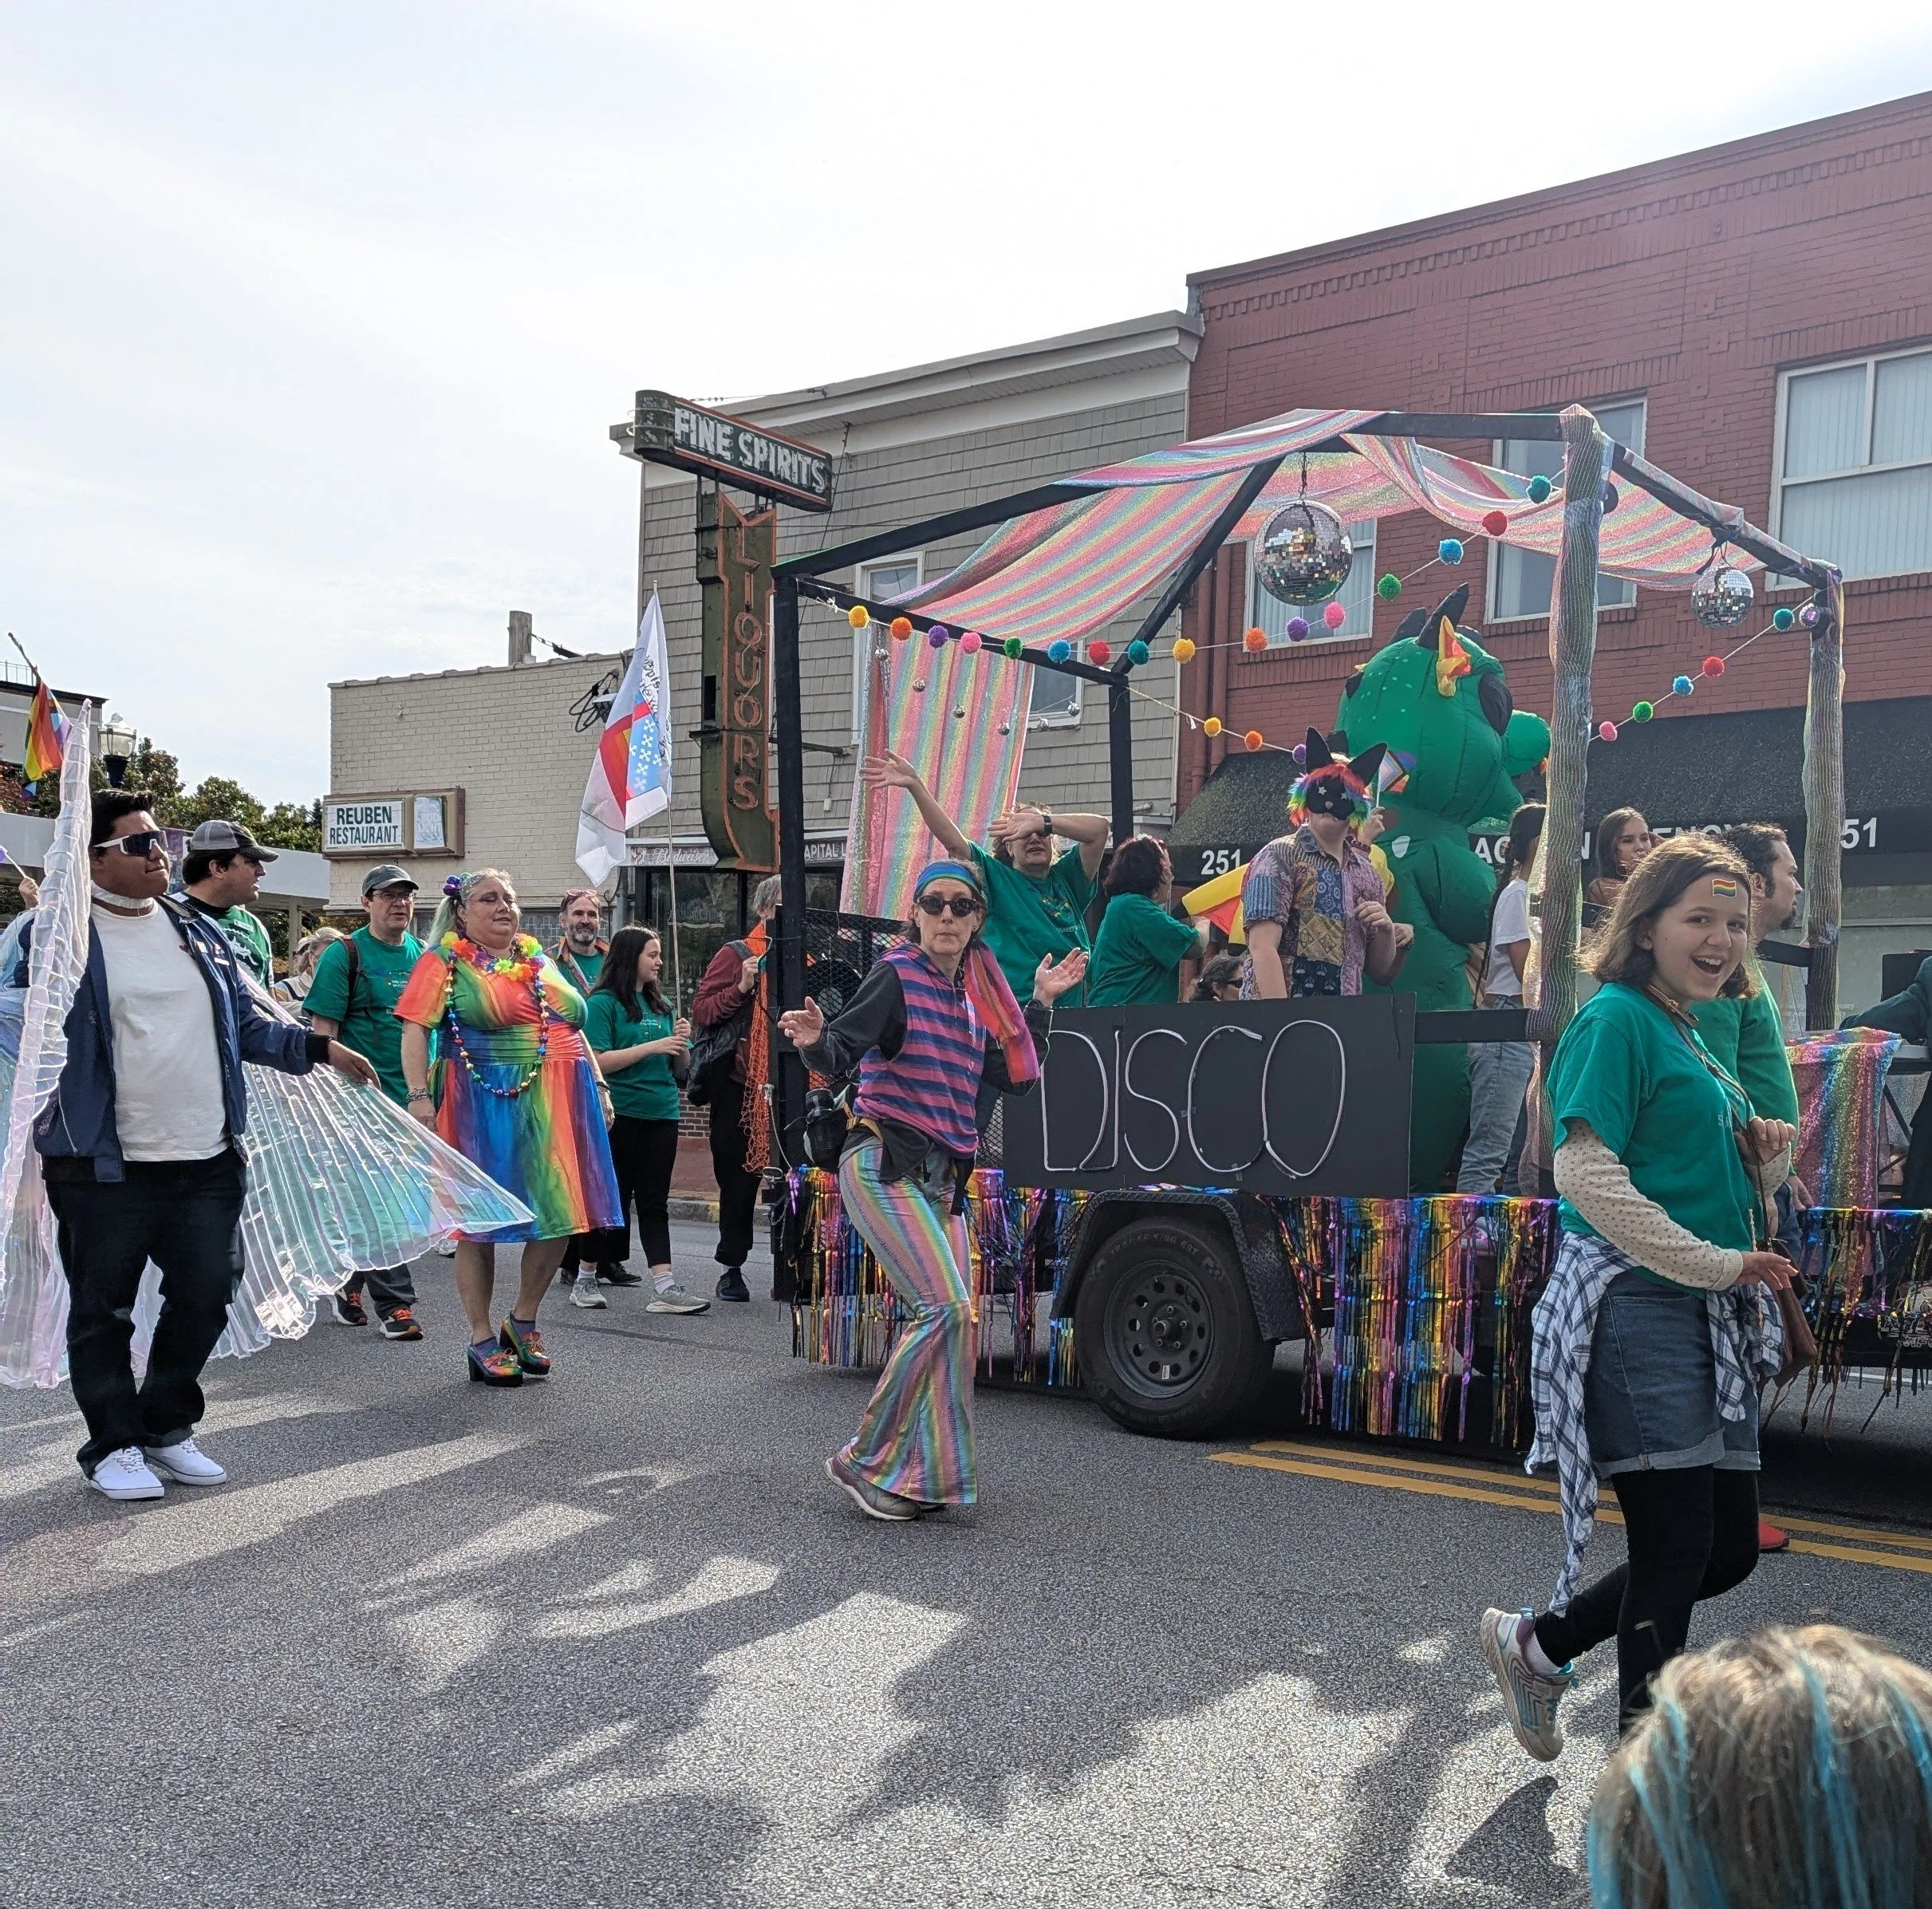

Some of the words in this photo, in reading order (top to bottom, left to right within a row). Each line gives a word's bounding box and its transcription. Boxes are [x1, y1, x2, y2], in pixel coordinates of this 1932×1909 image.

[674, 408, 734, 461] FINE
[739, 432, 826, 493] SPIRITS
[733, 526, 767, 809] LIQUORS
[336, 806, 392, 825] REUBEN
[329, 825, 399, 844] RESTAURANT
[1840, 817, 1878, 849] 51
[804, 842, 838, 860] APITAL
[1201, 848, 1241, 875] 251
[1039, 1020, 1346, 1177] DISCO
